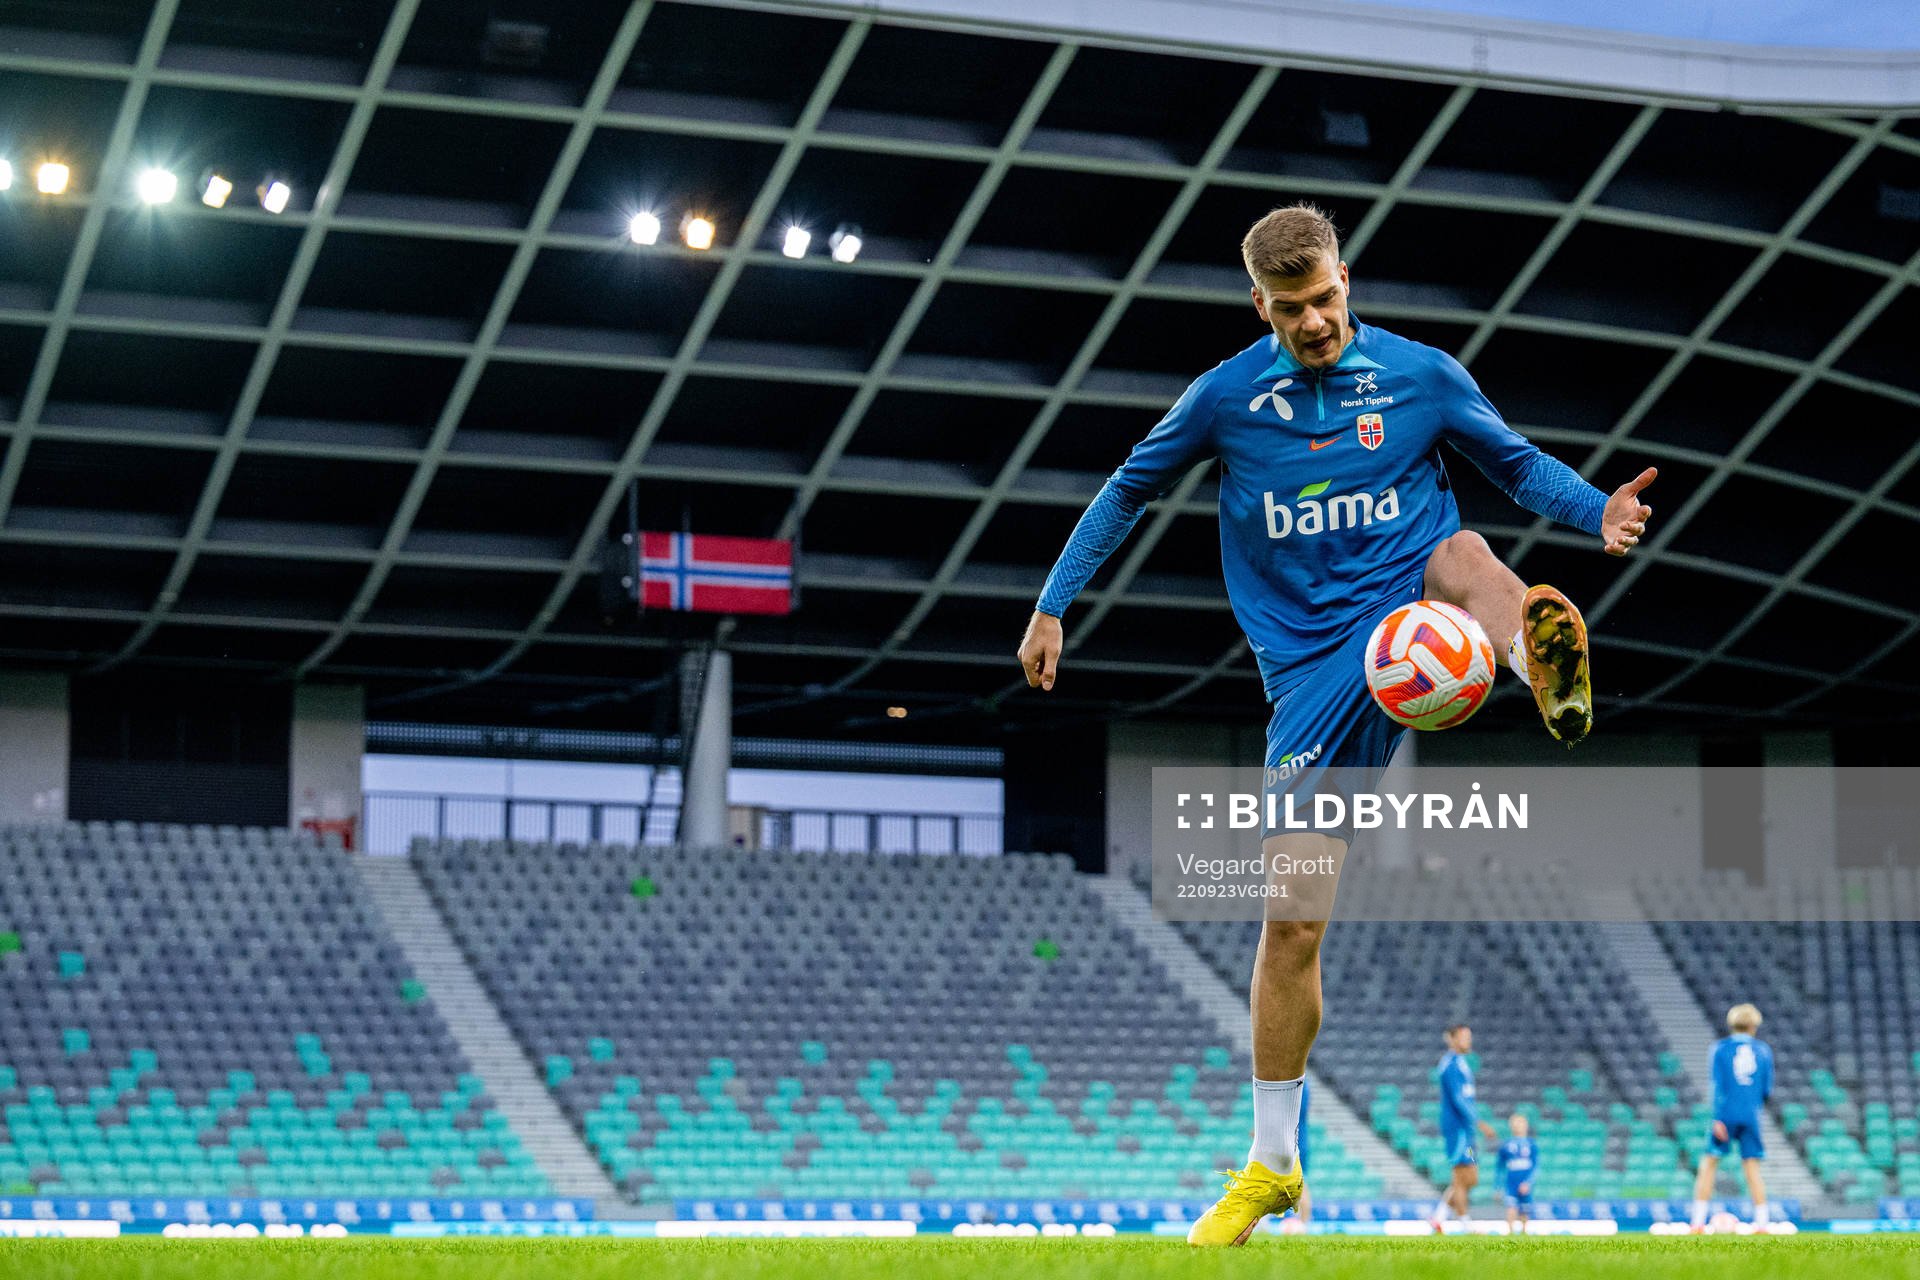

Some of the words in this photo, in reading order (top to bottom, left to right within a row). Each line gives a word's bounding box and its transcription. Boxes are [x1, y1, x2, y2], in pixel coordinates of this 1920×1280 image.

[1341, 399, 1364, 408] Norsk
[1364, 396, 1394, 406] Tipping
[1264, 486, 1400, 539] bama
